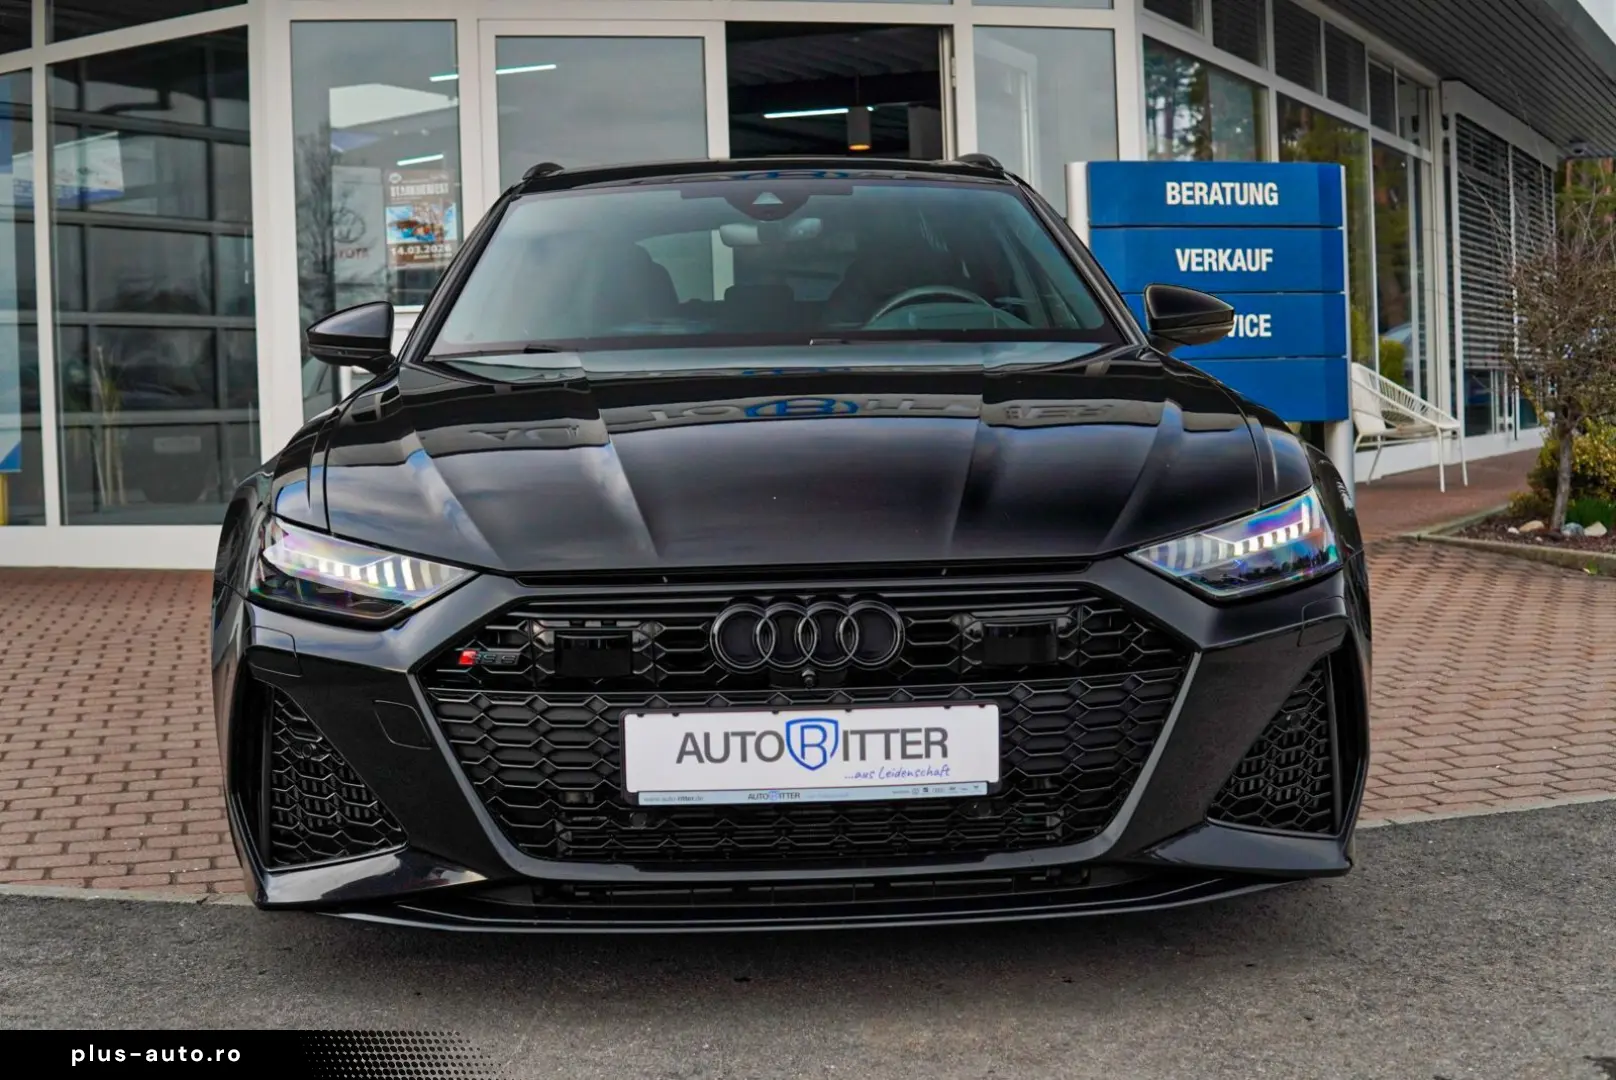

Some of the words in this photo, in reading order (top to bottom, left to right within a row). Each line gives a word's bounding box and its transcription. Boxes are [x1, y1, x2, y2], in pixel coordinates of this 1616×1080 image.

[1165, 181, 1279, 206] BERATUNG
[1175, 248, 1273, 272] VERKAUF
[1227, 314, 1272, 337] VICE
[879, 763, 951, 780] Leidenschaft
